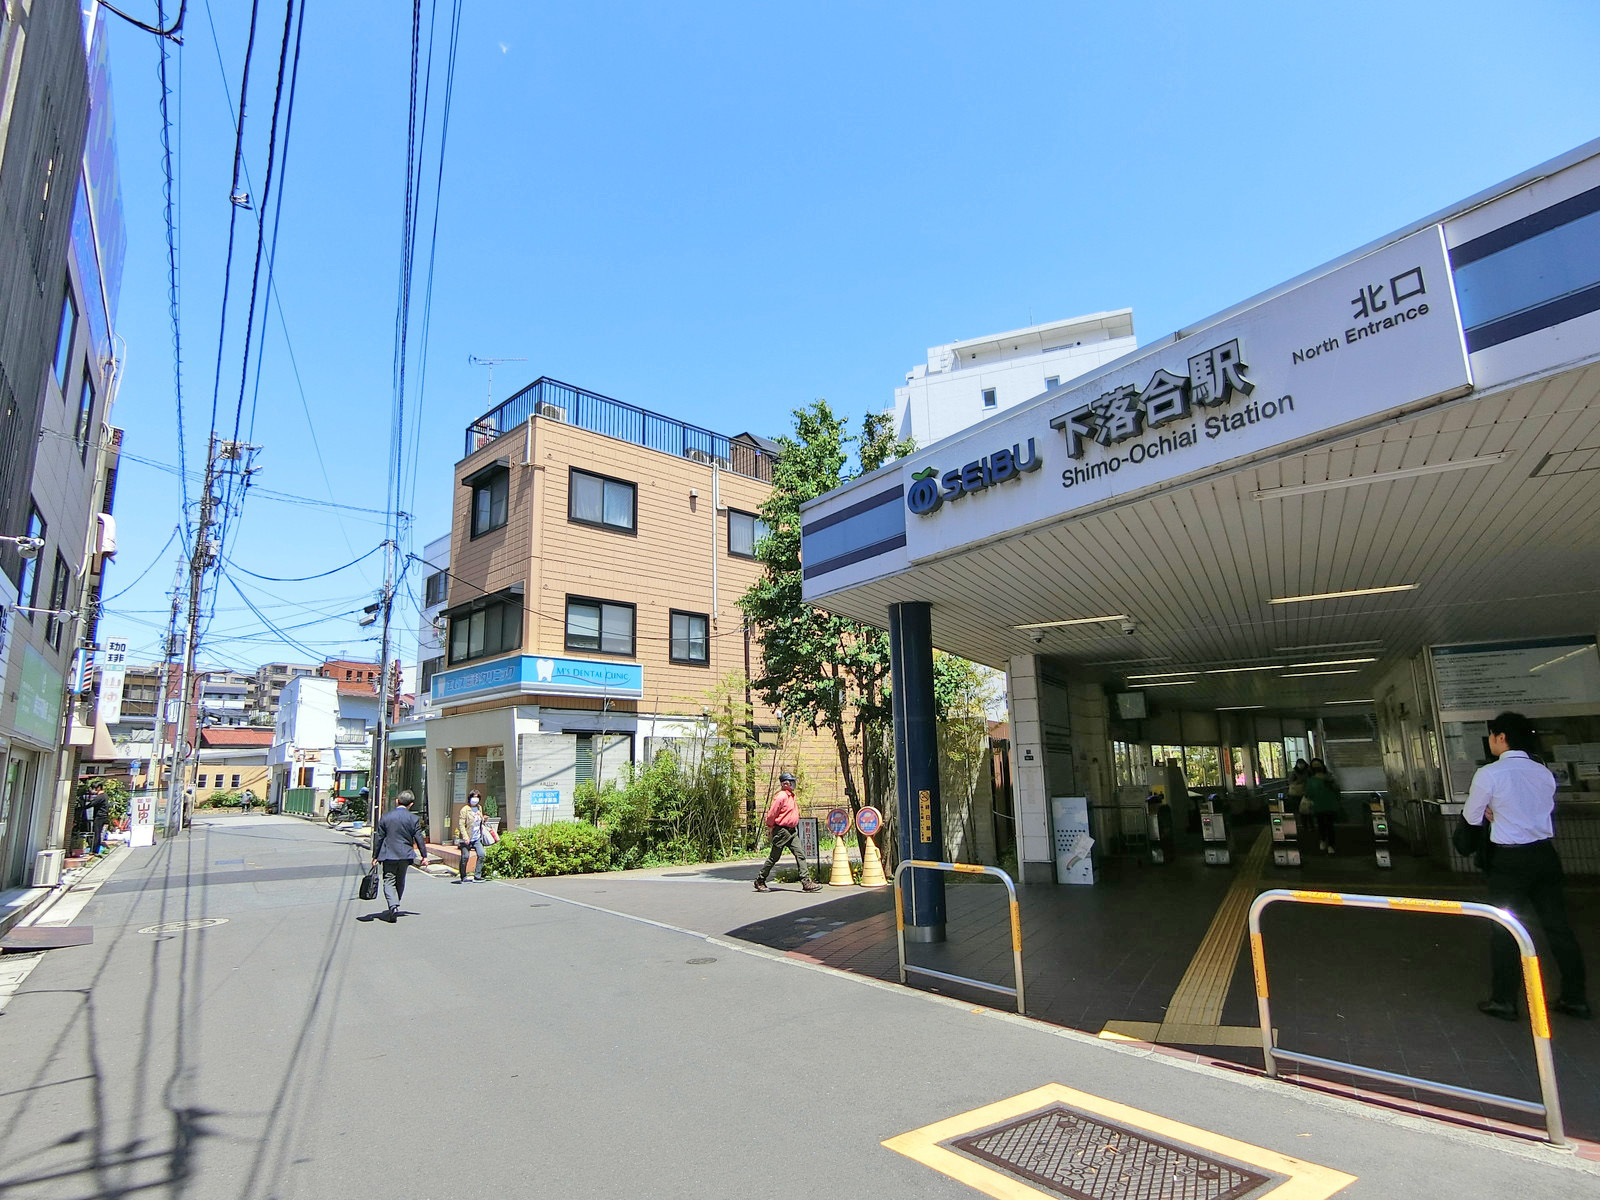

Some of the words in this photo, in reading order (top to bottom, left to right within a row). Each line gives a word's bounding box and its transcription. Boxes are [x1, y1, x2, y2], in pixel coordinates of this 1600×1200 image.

[1350, 265, 1427, 320] 北口
[1291, 337, 1340, 365] North
[1345, 303, 1430, 345] Entrance
[1049, 337, 1255, 460] 下落合駅
[941, 436, 1040, 502] SEIBU
[1061, 424, 1198, 489] Shimo-Ochiai
[1204, 394, 1295, 439] Station
[107, 641, 127, 663] 珈琲
[446, 664, 515, 692] エムス歯科クリニック
